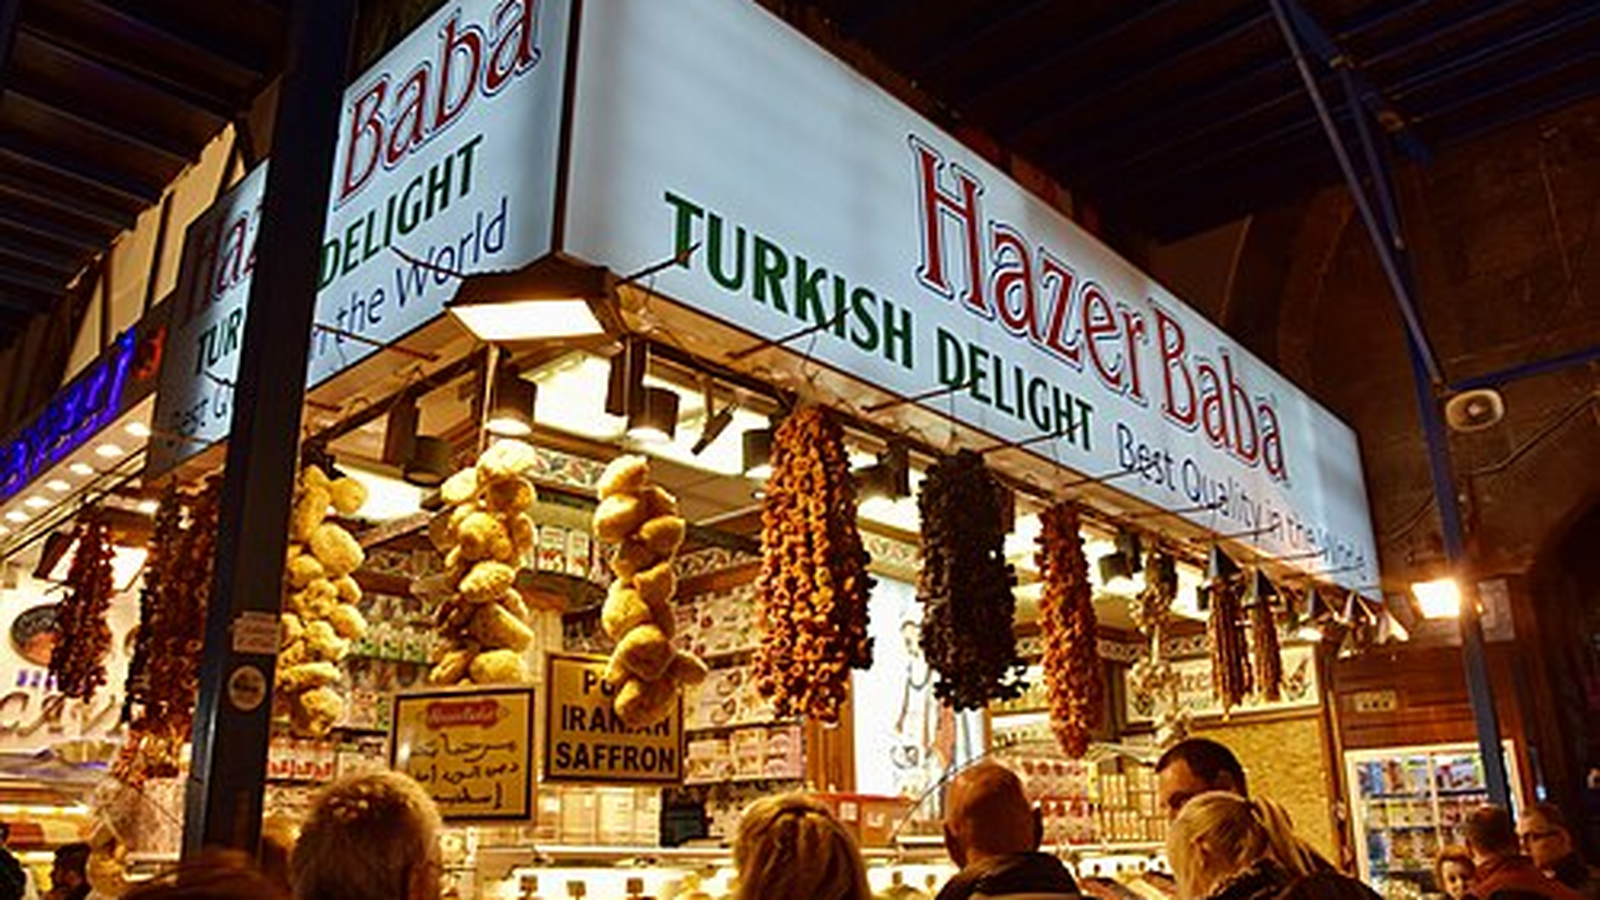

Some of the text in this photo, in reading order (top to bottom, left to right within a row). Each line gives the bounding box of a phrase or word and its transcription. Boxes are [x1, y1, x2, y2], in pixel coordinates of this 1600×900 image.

[334, 0, 541, 211] Baba
[318, 134, 483, 292] DELIGHT
[336, 287, 385, 343] the
[396, 197, 508, 308] World
[664, 191, 1093, 452] TURKISH DELIGHT
[908, 134, 1291, 488] Hazer Baba
[1116, 423, 1176, 491] Best
[555, 742, 675, 773] SAFFRON
[562, 704, 670, 737] IRANN
